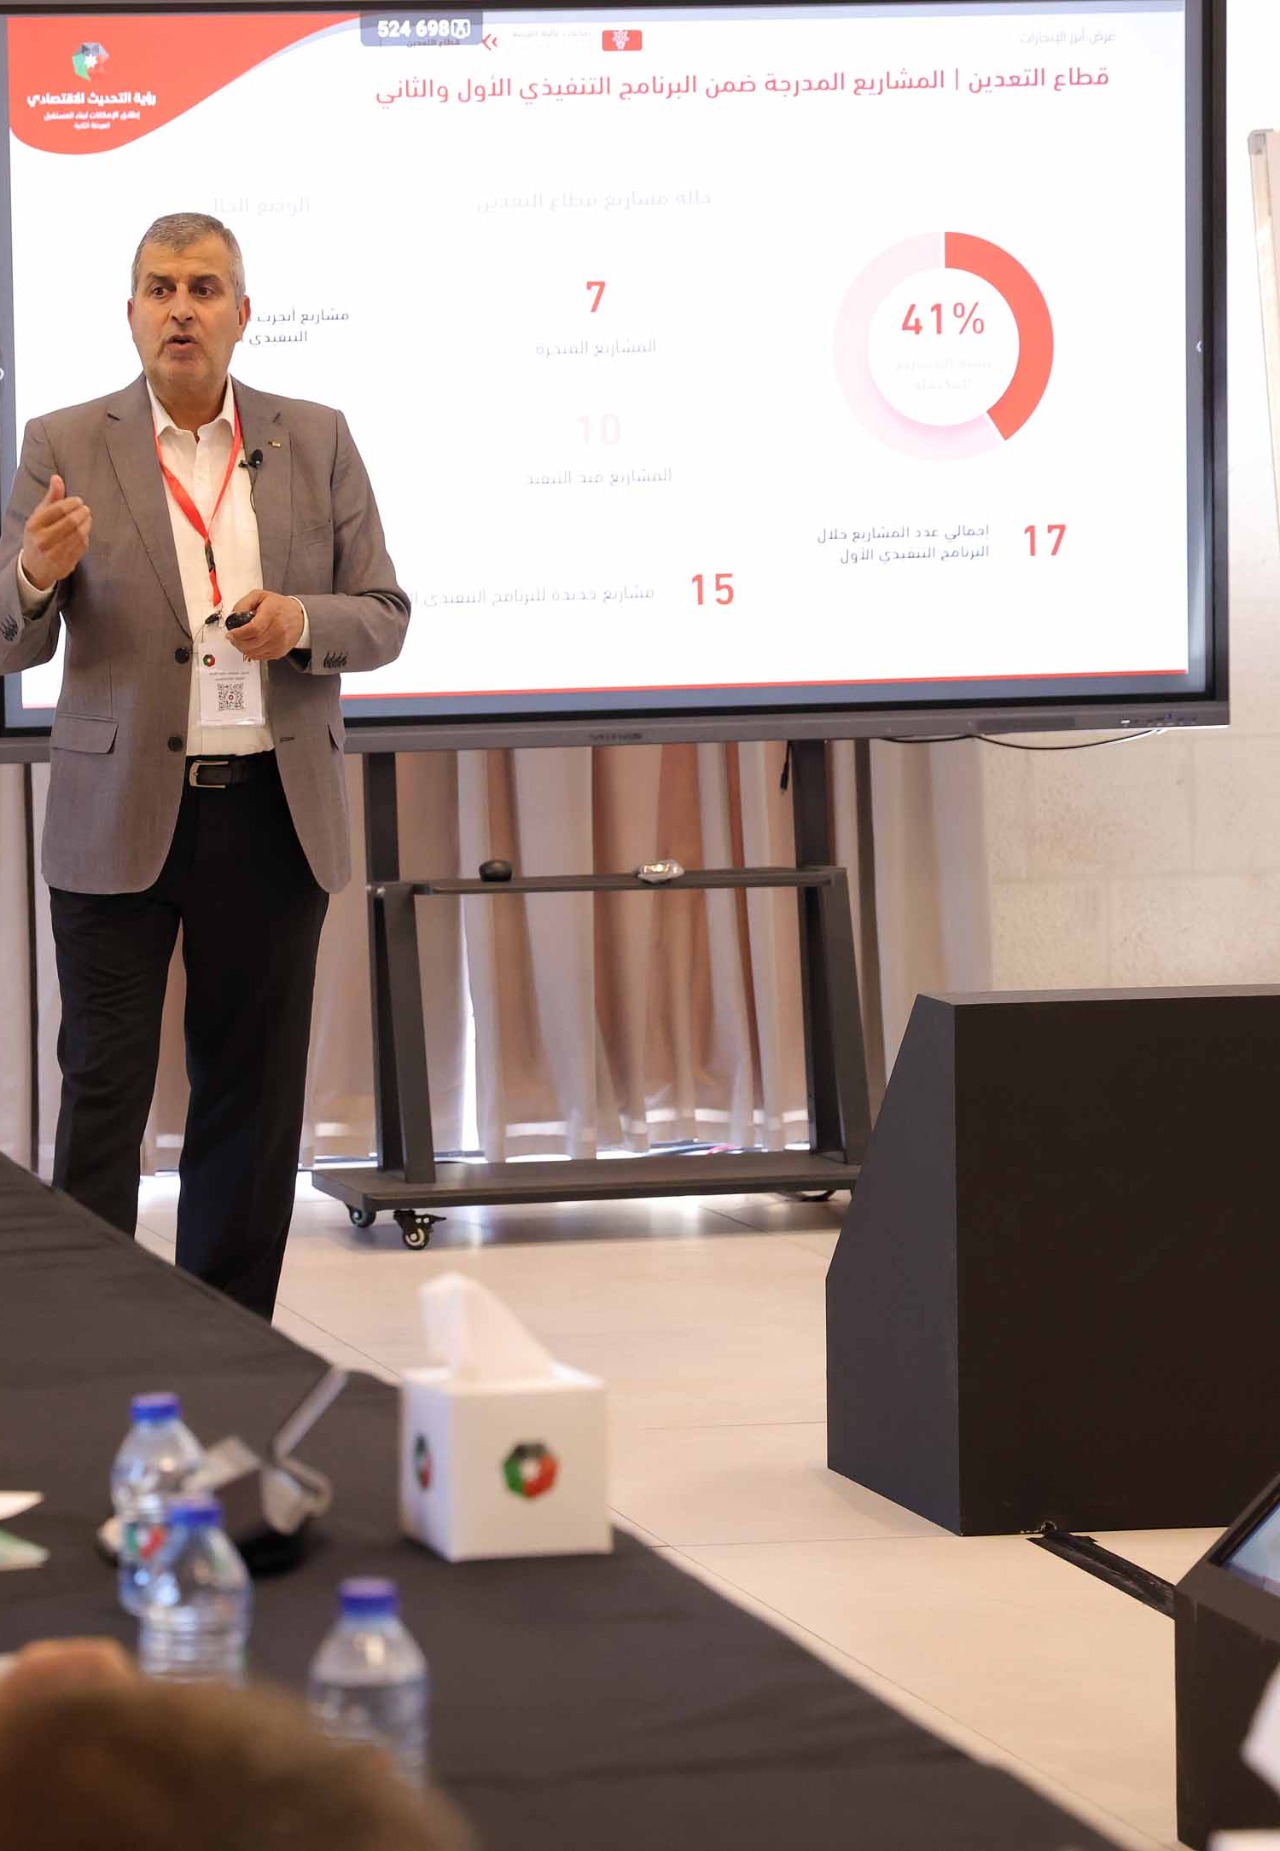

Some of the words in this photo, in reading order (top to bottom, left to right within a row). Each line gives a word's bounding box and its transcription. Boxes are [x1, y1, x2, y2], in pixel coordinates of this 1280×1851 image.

[378, 19, 411, 38] 524
[416, 19, 450, 37] 698
[457, 73, 512, 103] الأول
[618, 74, 697, 100] البرنامج
[705, 73, 756, 99] ضمن
[764, 72, 845, 98] المدرجة
[853, 68, 945, 96] المشاريع
[968, 66, 1045, 94] التعدين
[1053, 65, 1110, 89] قطاع
[26, 91, 86, 108] الاقتصادي
[87, 90, 131, 107] التحديث
[133, 91, 157, 107] رؤية
[375, 75, 449, 108] والثاني
[519, 76, 611, 106] التنفيذي
[585, 280, 606, 314] 7
[300, 307, 350, 325] مشاريع
[900, 301, 986, 336] 41%
[577, 413, 622, 447] 10
[851, 525, 910, 542] المشاريع
[915, 527, 939, 539] عدد
[1023, 524, 1068, 557] 17
[840, 545, 874, 565] الأول
[691, 572, 735, 606] 15
